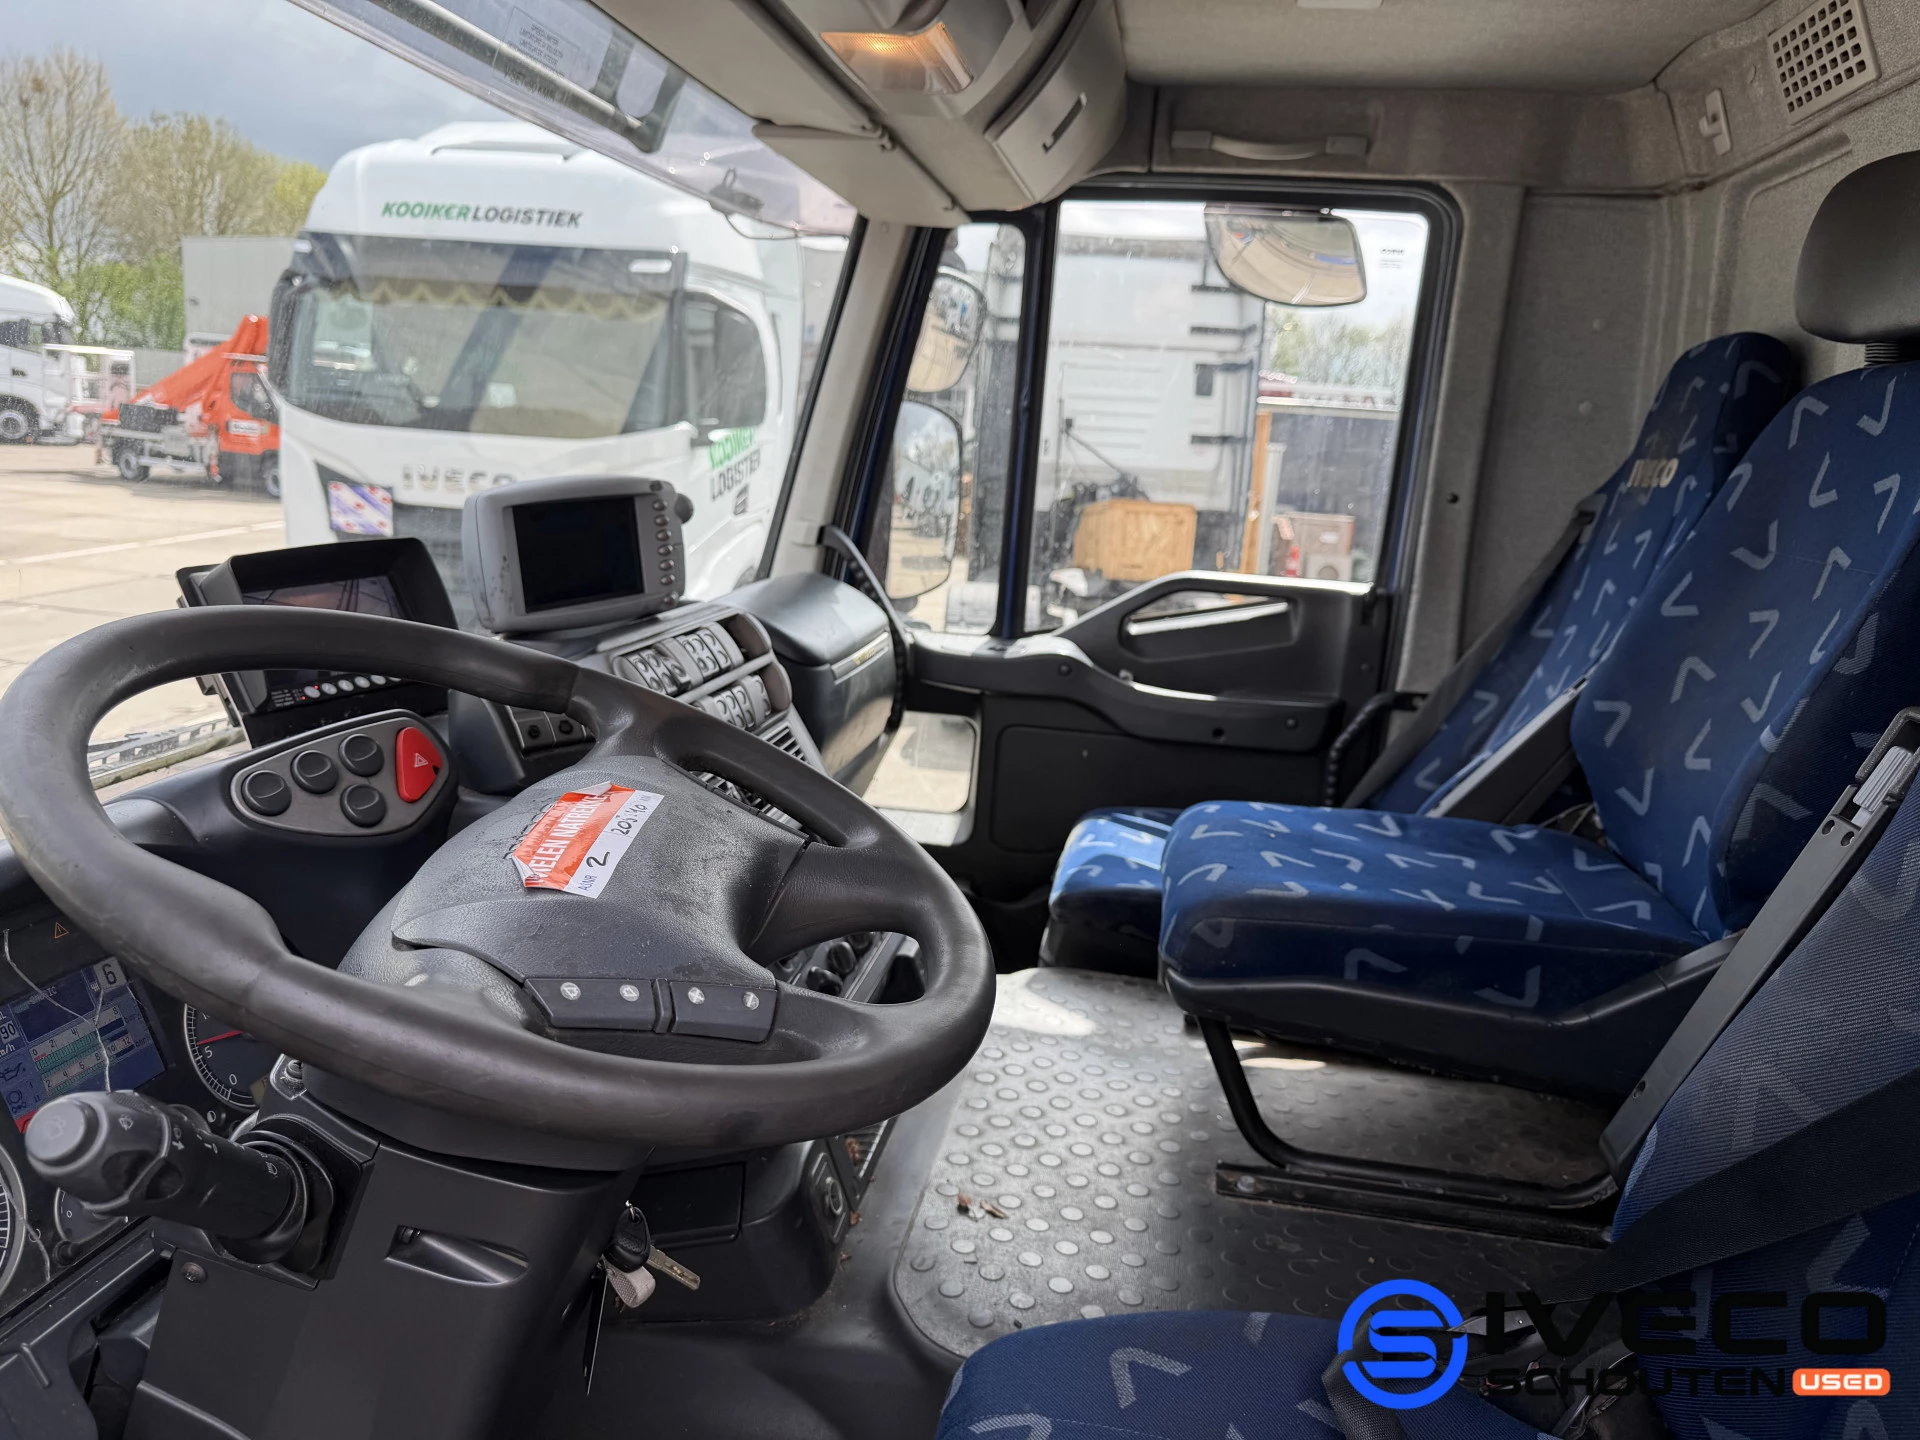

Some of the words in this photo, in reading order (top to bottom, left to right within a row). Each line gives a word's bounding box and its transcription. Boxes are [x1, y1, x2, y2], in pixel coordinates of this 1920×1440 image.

[102, 964, 117, 985] 6
[0, 1023, 16, 1040] 90
[204, 1045, 213, 1059] 5
[229, 1073, 238, 1086] 0
